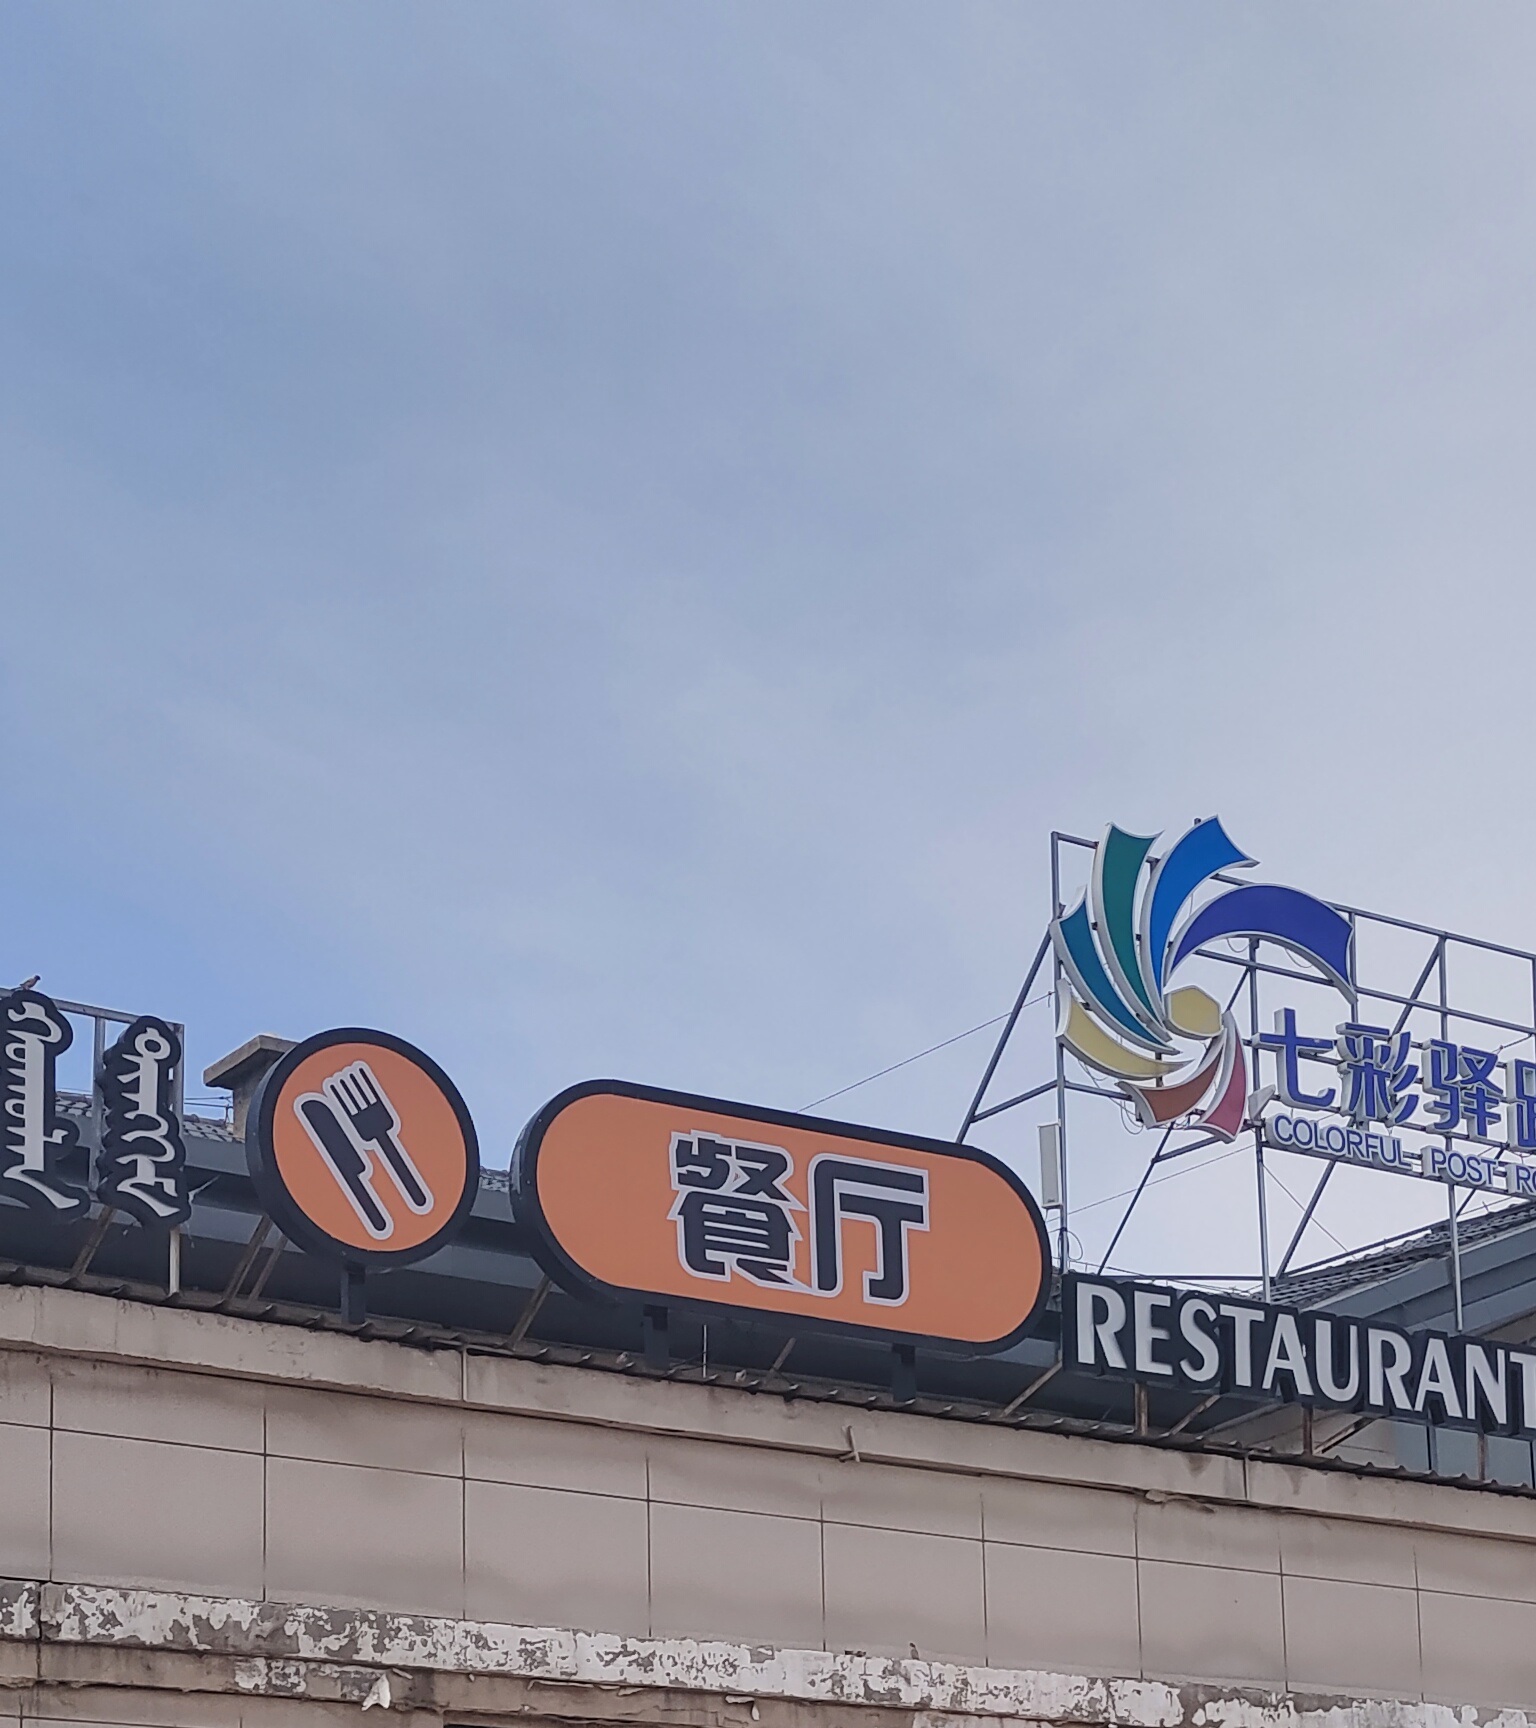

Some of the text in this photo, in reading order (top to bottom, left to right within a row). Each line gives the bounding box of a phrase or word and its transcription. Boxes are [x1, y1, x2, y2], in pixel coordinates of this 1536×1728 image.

[1273, 1113, 1414, 1170] COLORFUL
[1430, 1148, 1499, 1187] POST
[670, 1132, 929, 1306] 餐厅
